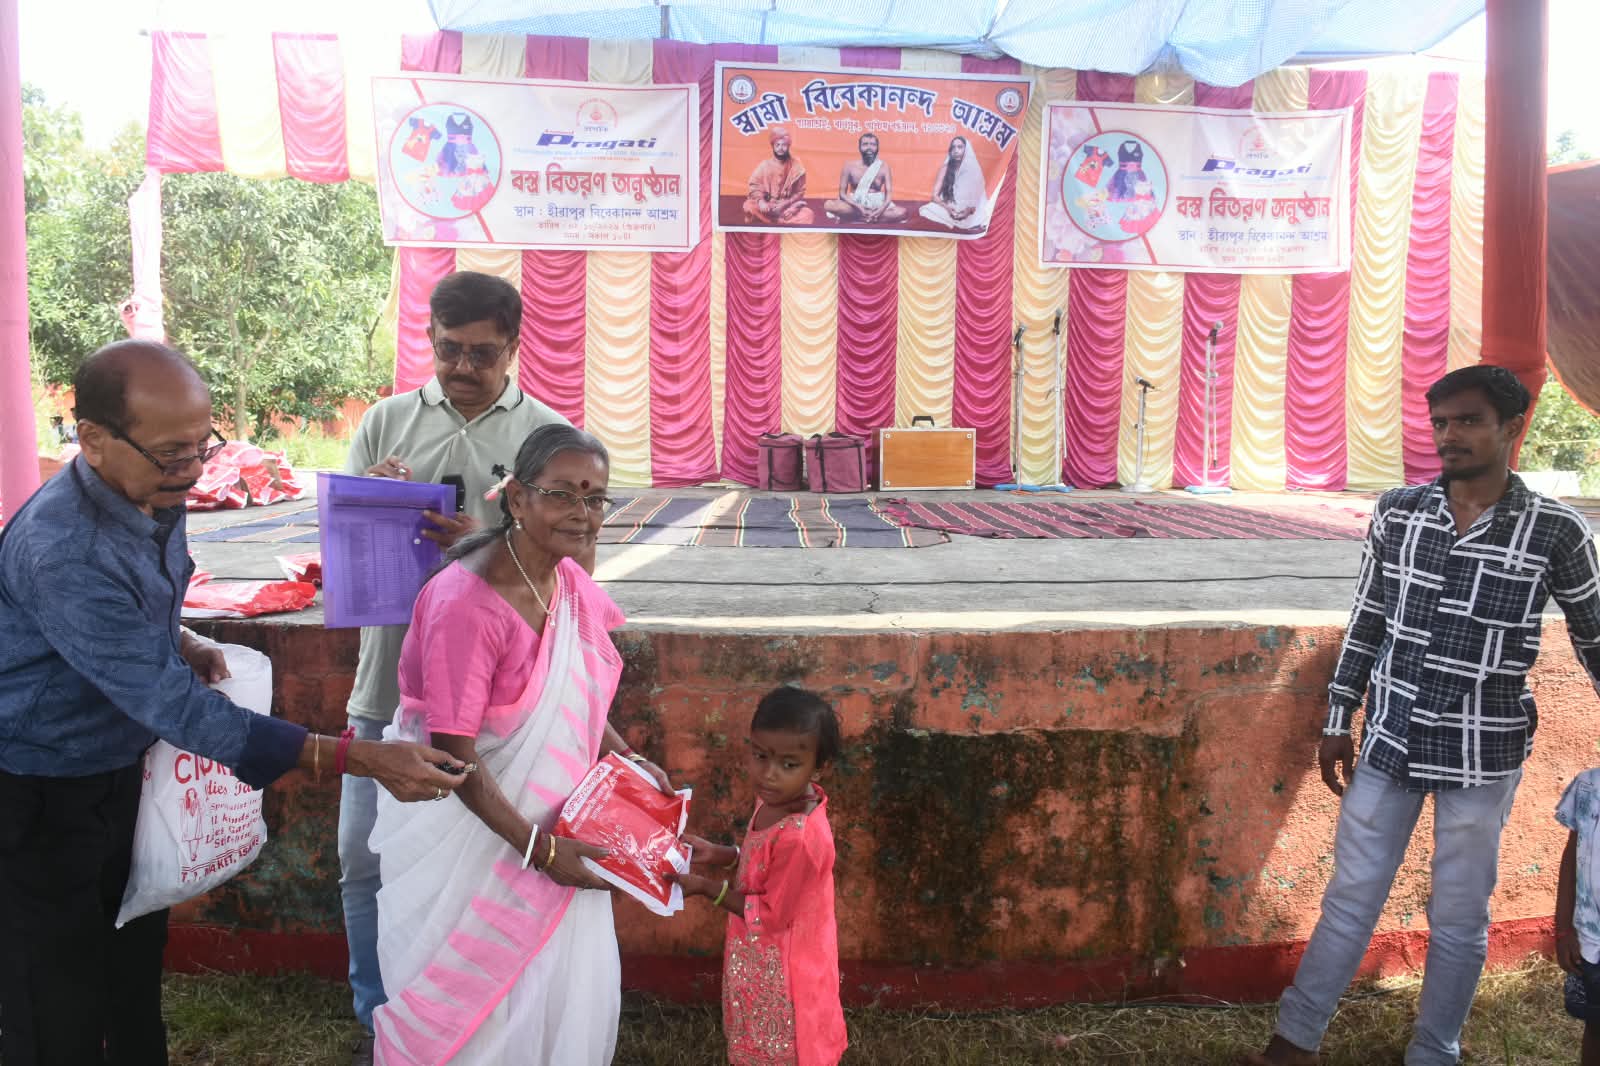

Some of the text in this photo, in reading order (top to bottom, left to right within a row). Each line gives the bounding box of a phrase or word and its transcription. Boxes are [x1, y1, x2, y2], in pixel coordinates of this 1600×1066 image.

[730, 92, 790, 135] স্বামী
[801, 79, 938, 116] বিবেকানন্দ
[950, 97, 1018, 151] আশ্রম
[535, 131, 657, 150] Pragati
[1201, 157, 1313, 179] Pragati
[510, 162, 681, 202] বস্ত্র বিতরণ অনুষ্ঠান
[546, 202, 586, 221] হীরাপুর
[589, 204, 642, 219] বিবেকানন্দ
[647, 208, 678, 220] আশ্রম
[1175, 187, 1331, 224] বস্ত্র বিতরণ অনুষ্ঠান
[1207, 226, 1244, 244] হীরাপুর
[1299, 230, 1328, 241] আশ্রম
[205, 779, 252, 796] dies Ta
[222, 812, 250, 824] kinds
